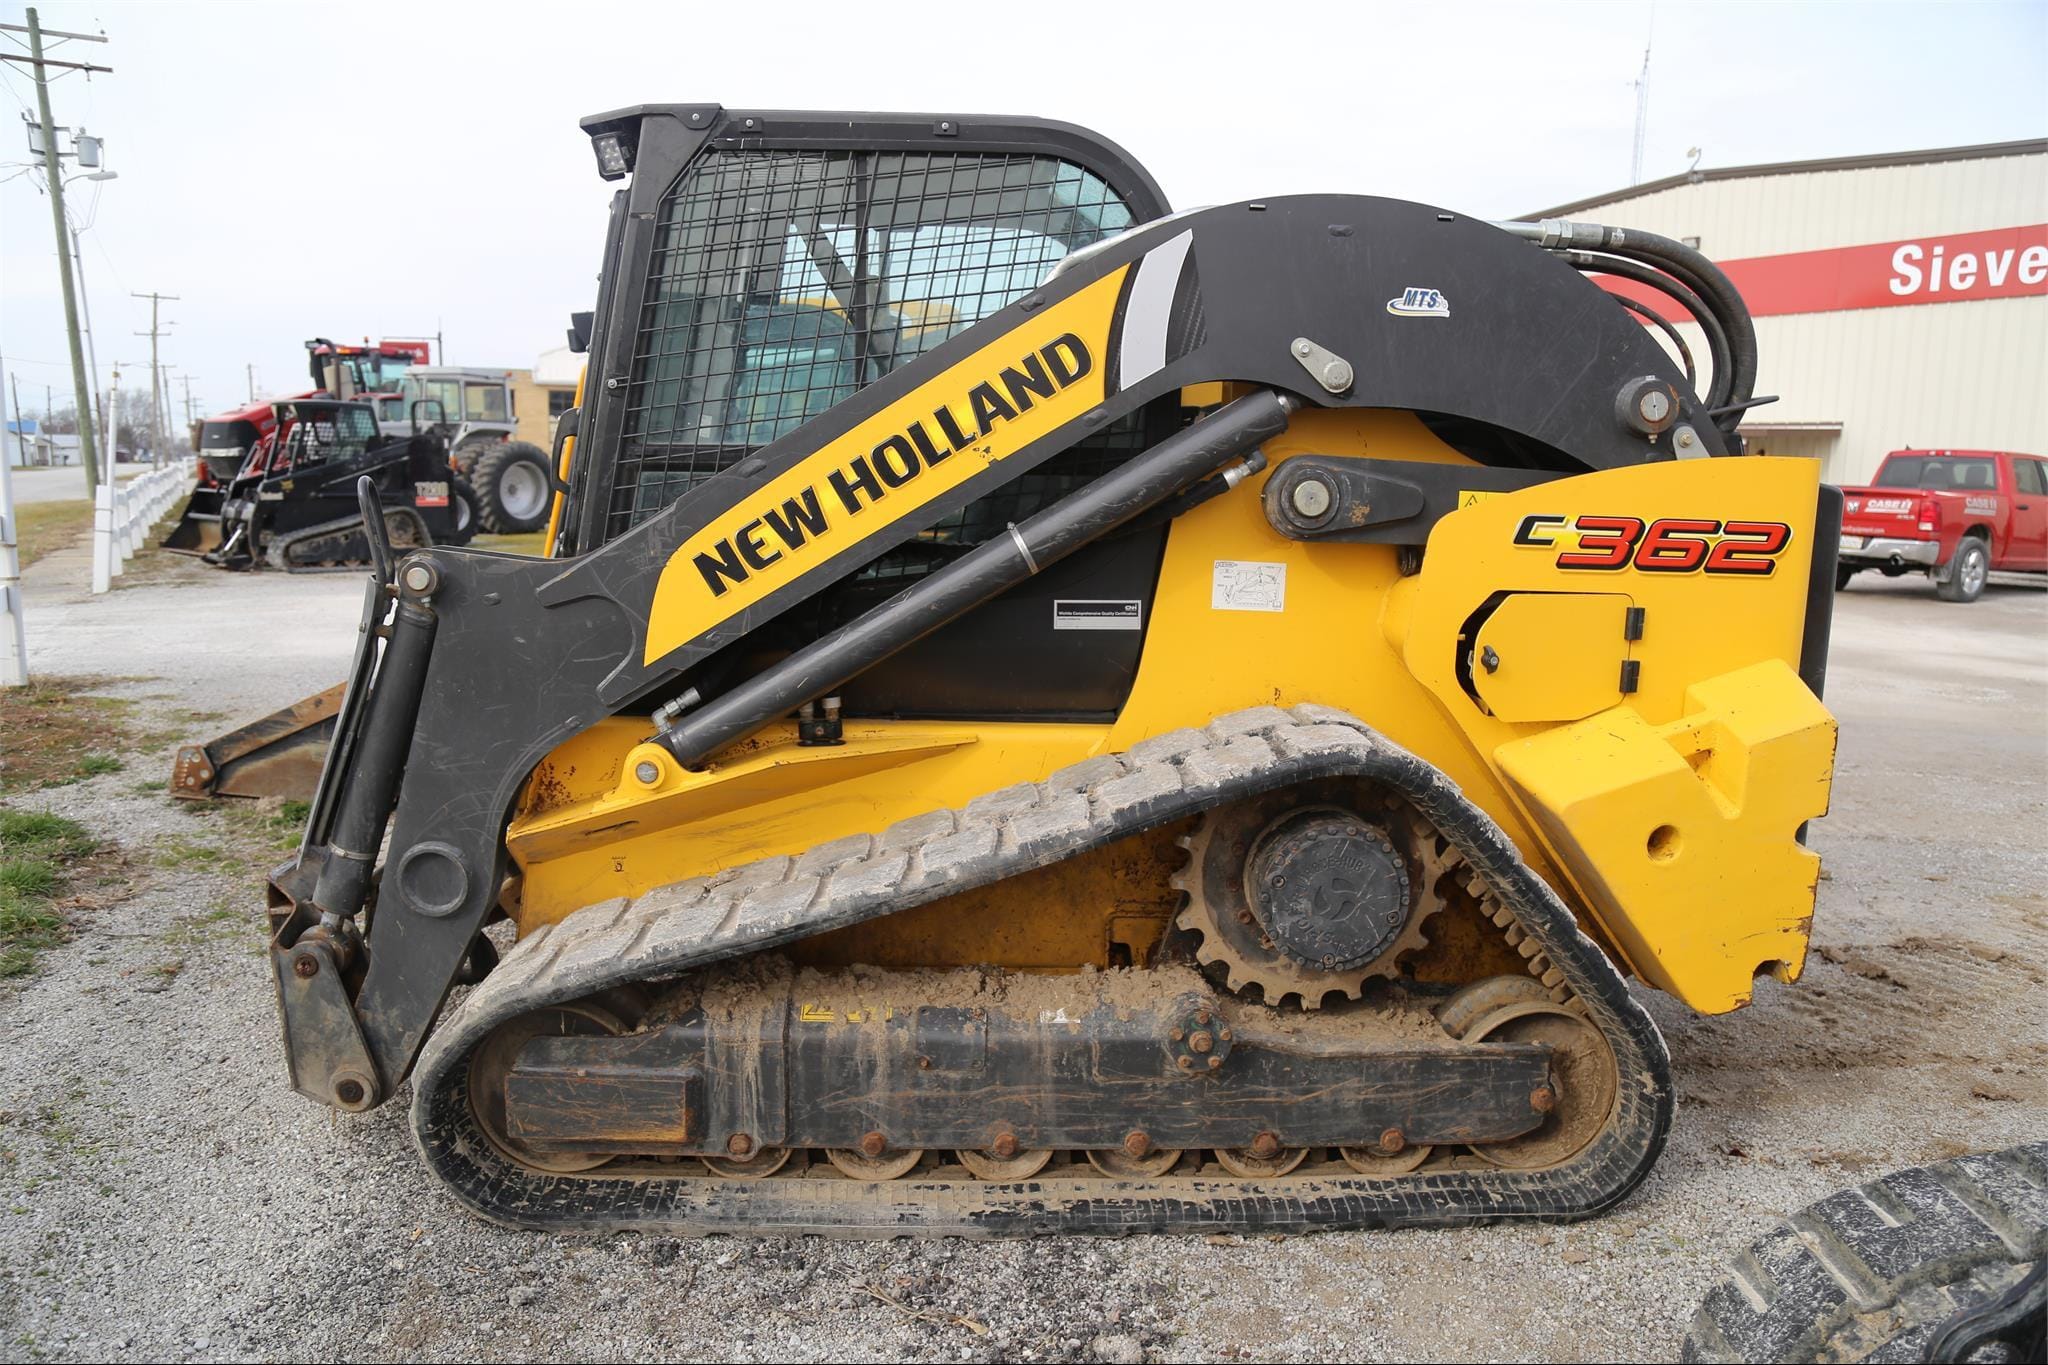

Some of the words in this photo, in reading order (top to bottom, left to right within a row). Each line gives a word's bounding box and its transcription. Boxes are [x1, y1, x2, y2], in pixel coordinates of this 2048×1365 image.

[1889, 244, 2048, 296] Sieve
[1403, 289, 1439, 308] MTS
[692, 485, 830, 597] NEW
[827, 333, 1093, 516] HOLLAND
[1867, 499, 1901, 509] CASE
